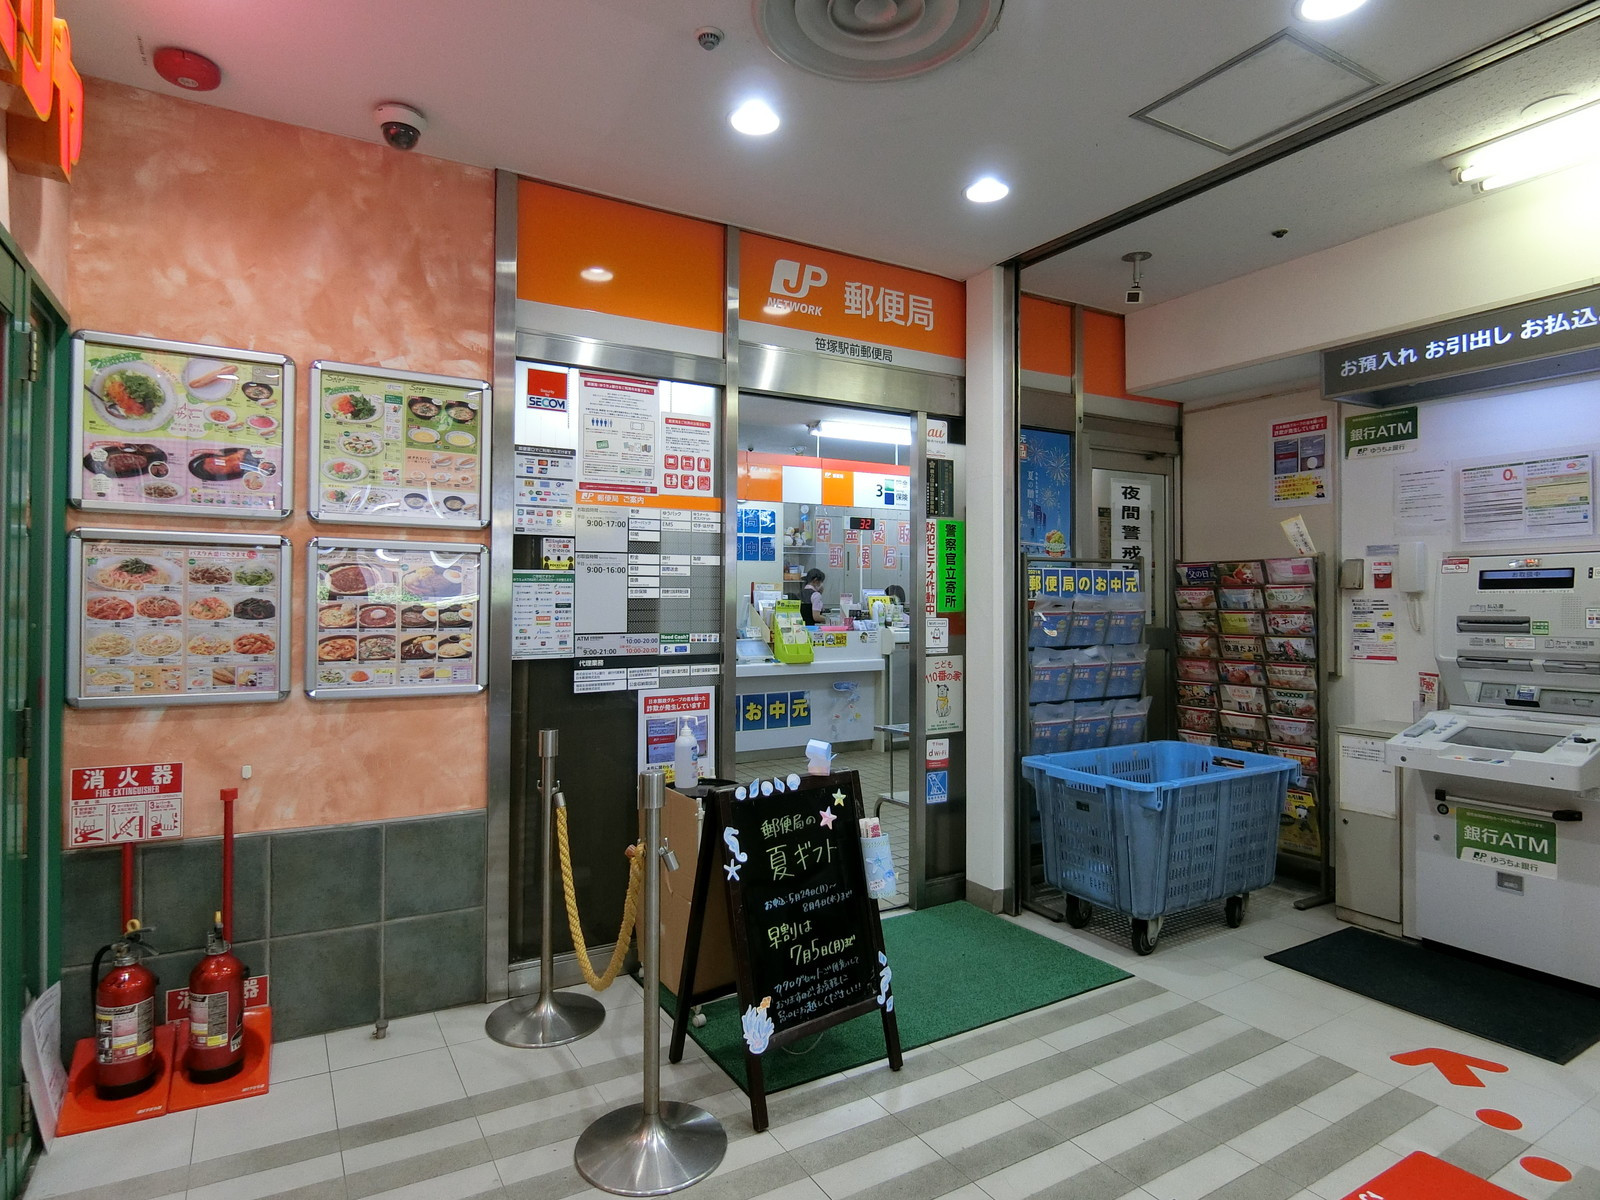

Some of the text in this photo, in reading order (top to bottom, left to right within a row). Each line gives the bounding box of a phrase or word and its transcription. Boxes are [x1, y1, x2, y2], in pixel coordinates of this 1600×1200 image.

[767, 297, 822, 317] NETWORK
[844, 281, 934, 331] 郵便局
[815, 337, 893, 362] 笹塚駅前郵便局
[1341, 306, 1600, 377] お預入れ お引出し お払込
[529, 397, 565, 410] SECOM
[927, 427, 945, 438] au
[1350, 421, 1412, 441] 銀行ATM
[1370, 444, 1405, 454] ゆうちょ銀行
[597, 494, 619, 503] 郵便局
[623, 495, 645, 504] ご案内
[875, 484, 883, 497] 3
[586, 520, 627, 528] 9:00-17:00
[859, 518, 871, 530] 32
[586, 566, 627, 574] 9:00-16:00
[926, 521, 935, 614] 防犯ビデオ作動中
[944, 523, 957, 608] 警察官立寄所
[1188, 569, 1209, 579] 父の日
[1029, 576, 1138, 593] 郵便局のお中元
[934, 660, 953, 669] こども
[925, 670, 963, 683] 110番の家
[745, 699, 809, 721] お中元
[82, 764, 174, 790] 消火器
[95, 785, 160, 798] FIRE EXTINGUISHER
[760, 814, 816, 840] 郵便局の
[1463, 824, 1550, 855] 銀行ATM
[766, 838, 837, 881] 夏ギフト
[1490, 855, 1539, 872] ゆうちょ銀行
[767, 920, 813, 949] 早割は
